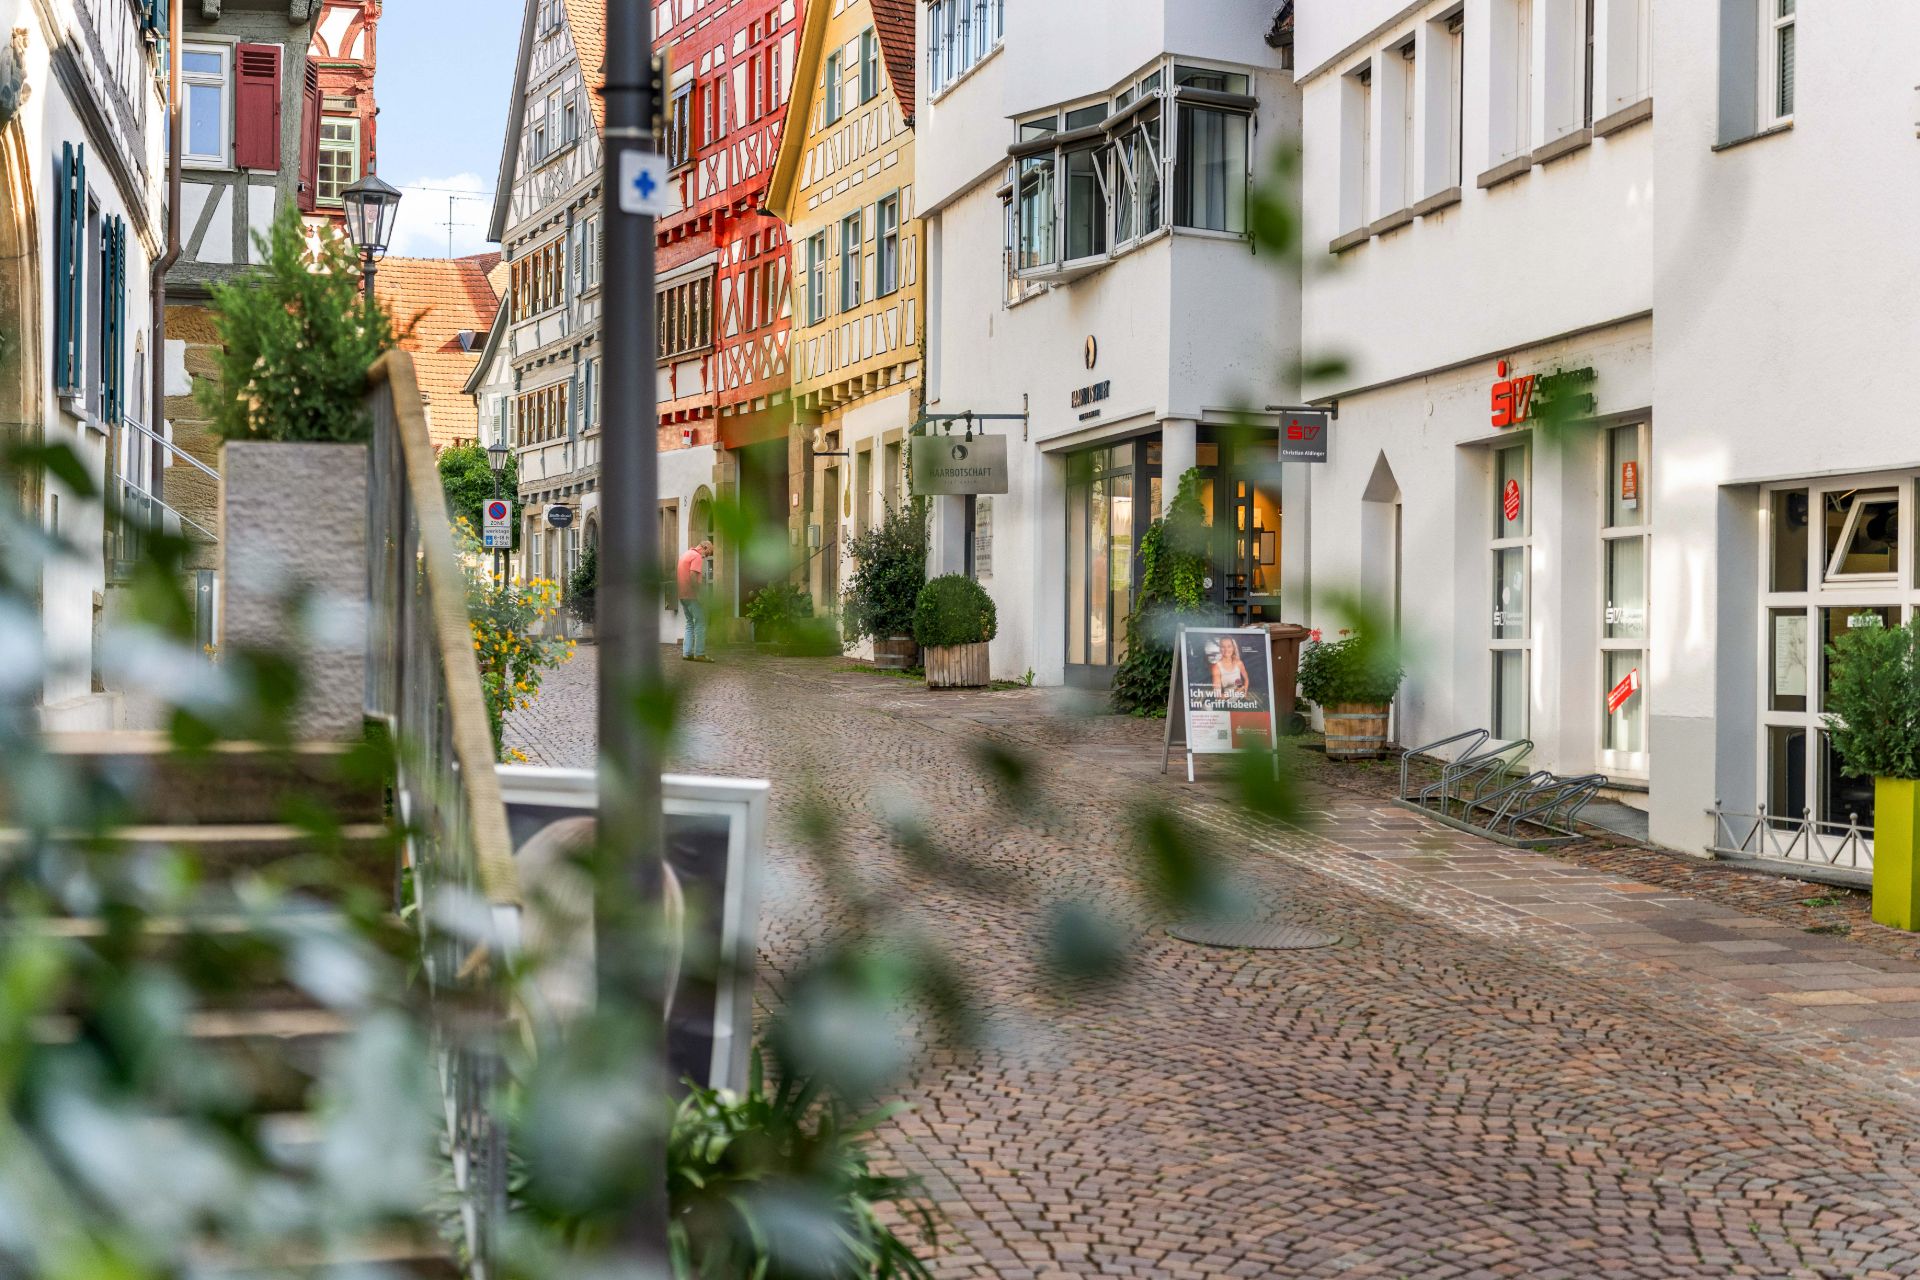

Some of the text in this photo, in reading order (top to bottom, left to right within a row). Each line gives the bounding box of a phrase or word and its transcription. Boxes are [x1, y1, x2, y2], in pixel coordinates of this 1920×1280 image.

[929, 467, 992, 478] HAARBOTSCHAFT
[1190, 688, 1245, 698] Ich will alles
[1191, 700, 1258, 709] im Griff haben!
